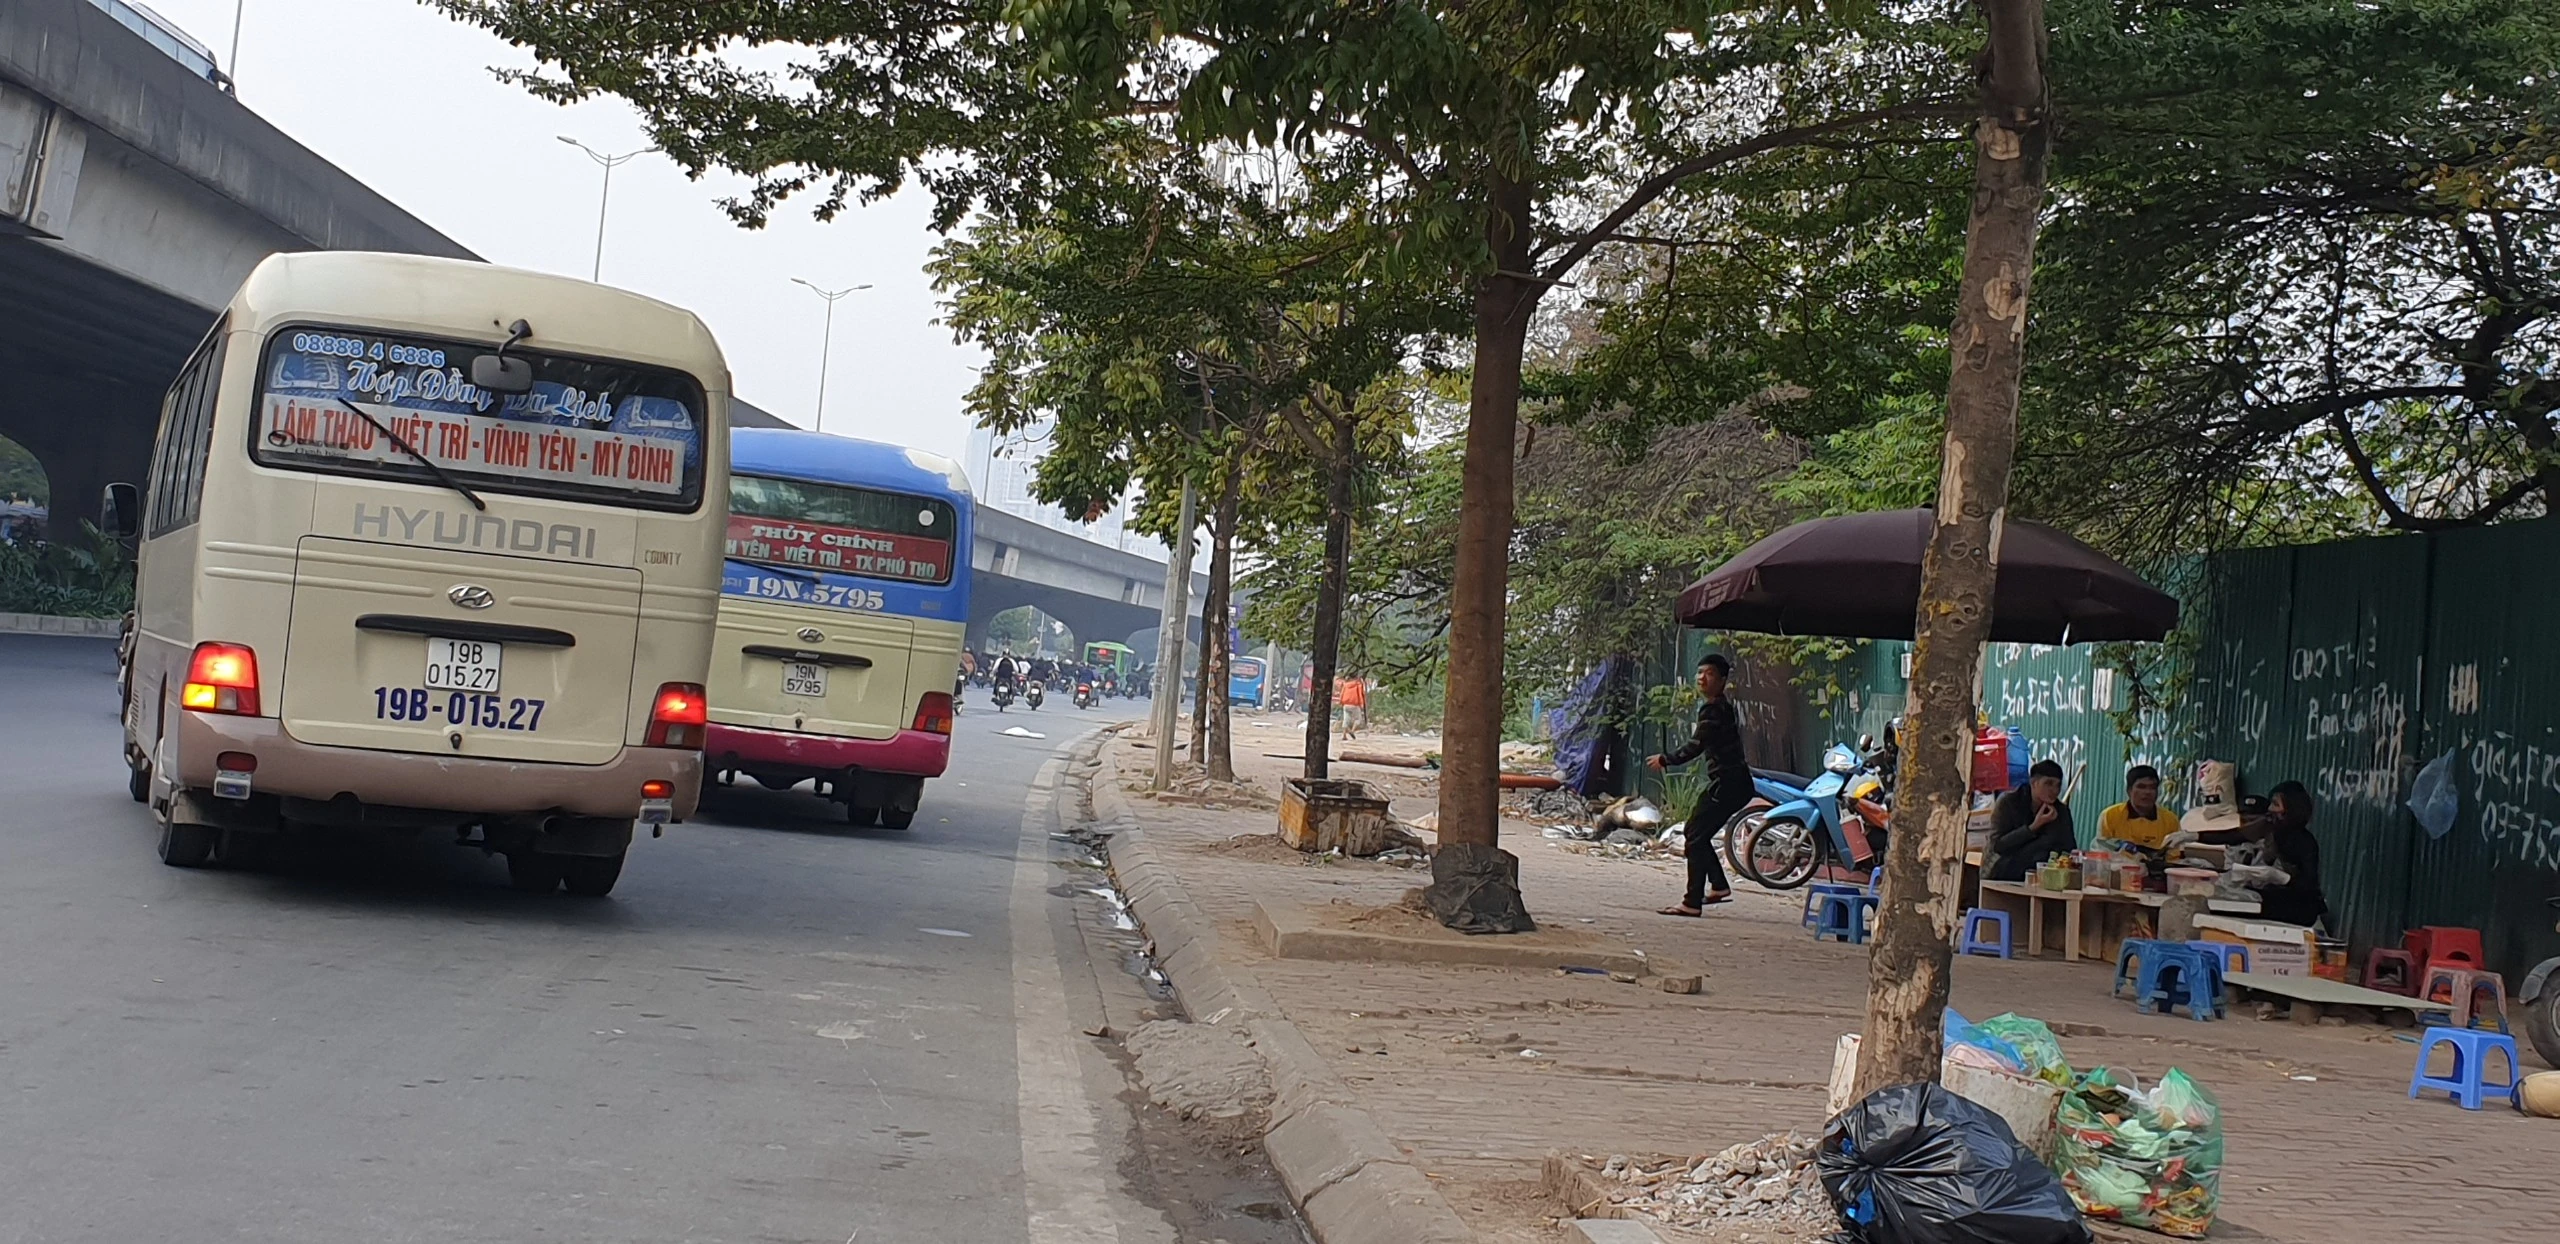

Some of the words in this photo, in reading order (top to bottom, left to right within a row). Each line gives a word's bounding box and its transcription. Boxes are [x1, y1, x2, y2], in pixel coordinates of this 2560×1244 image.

[293, 333, 364, 358] 08888
[367, 342, 385, 361] 4
[389, 344, 446, 368] 6886
[347, 360, 411, 403] Hợp
[551, 387, 614, 427] Lịch
[272, 399, 317, 443] LÂM
[390, 412, 433, 462] VIỆT
[439, 417, 469, 461] TRÌ
[484, 423, 530, 468] VĨNH
[538, 429, 576, 473] YÊN
[592, 436, 624, 478] MỸ
[627, 439, 675, 484] ĐÌNH
[353, 502, 597, 559] HYUNDAI
[751, 524, 817, 544] THỦY
[821, 532, 894, 553] CHÍNH
[741, 539, 771, 558] YÊN
[818, 548, 842, 567] TRÌ
[856, 554, 873, 571] TX
[876, 556, 906, 575] PHÚ
[447, 641, 483, 664] 19B
[427, 663, 497, 689] 015.27
[786, 678, 822, 695] 5795
[795, 664, 818, 681] 19N
